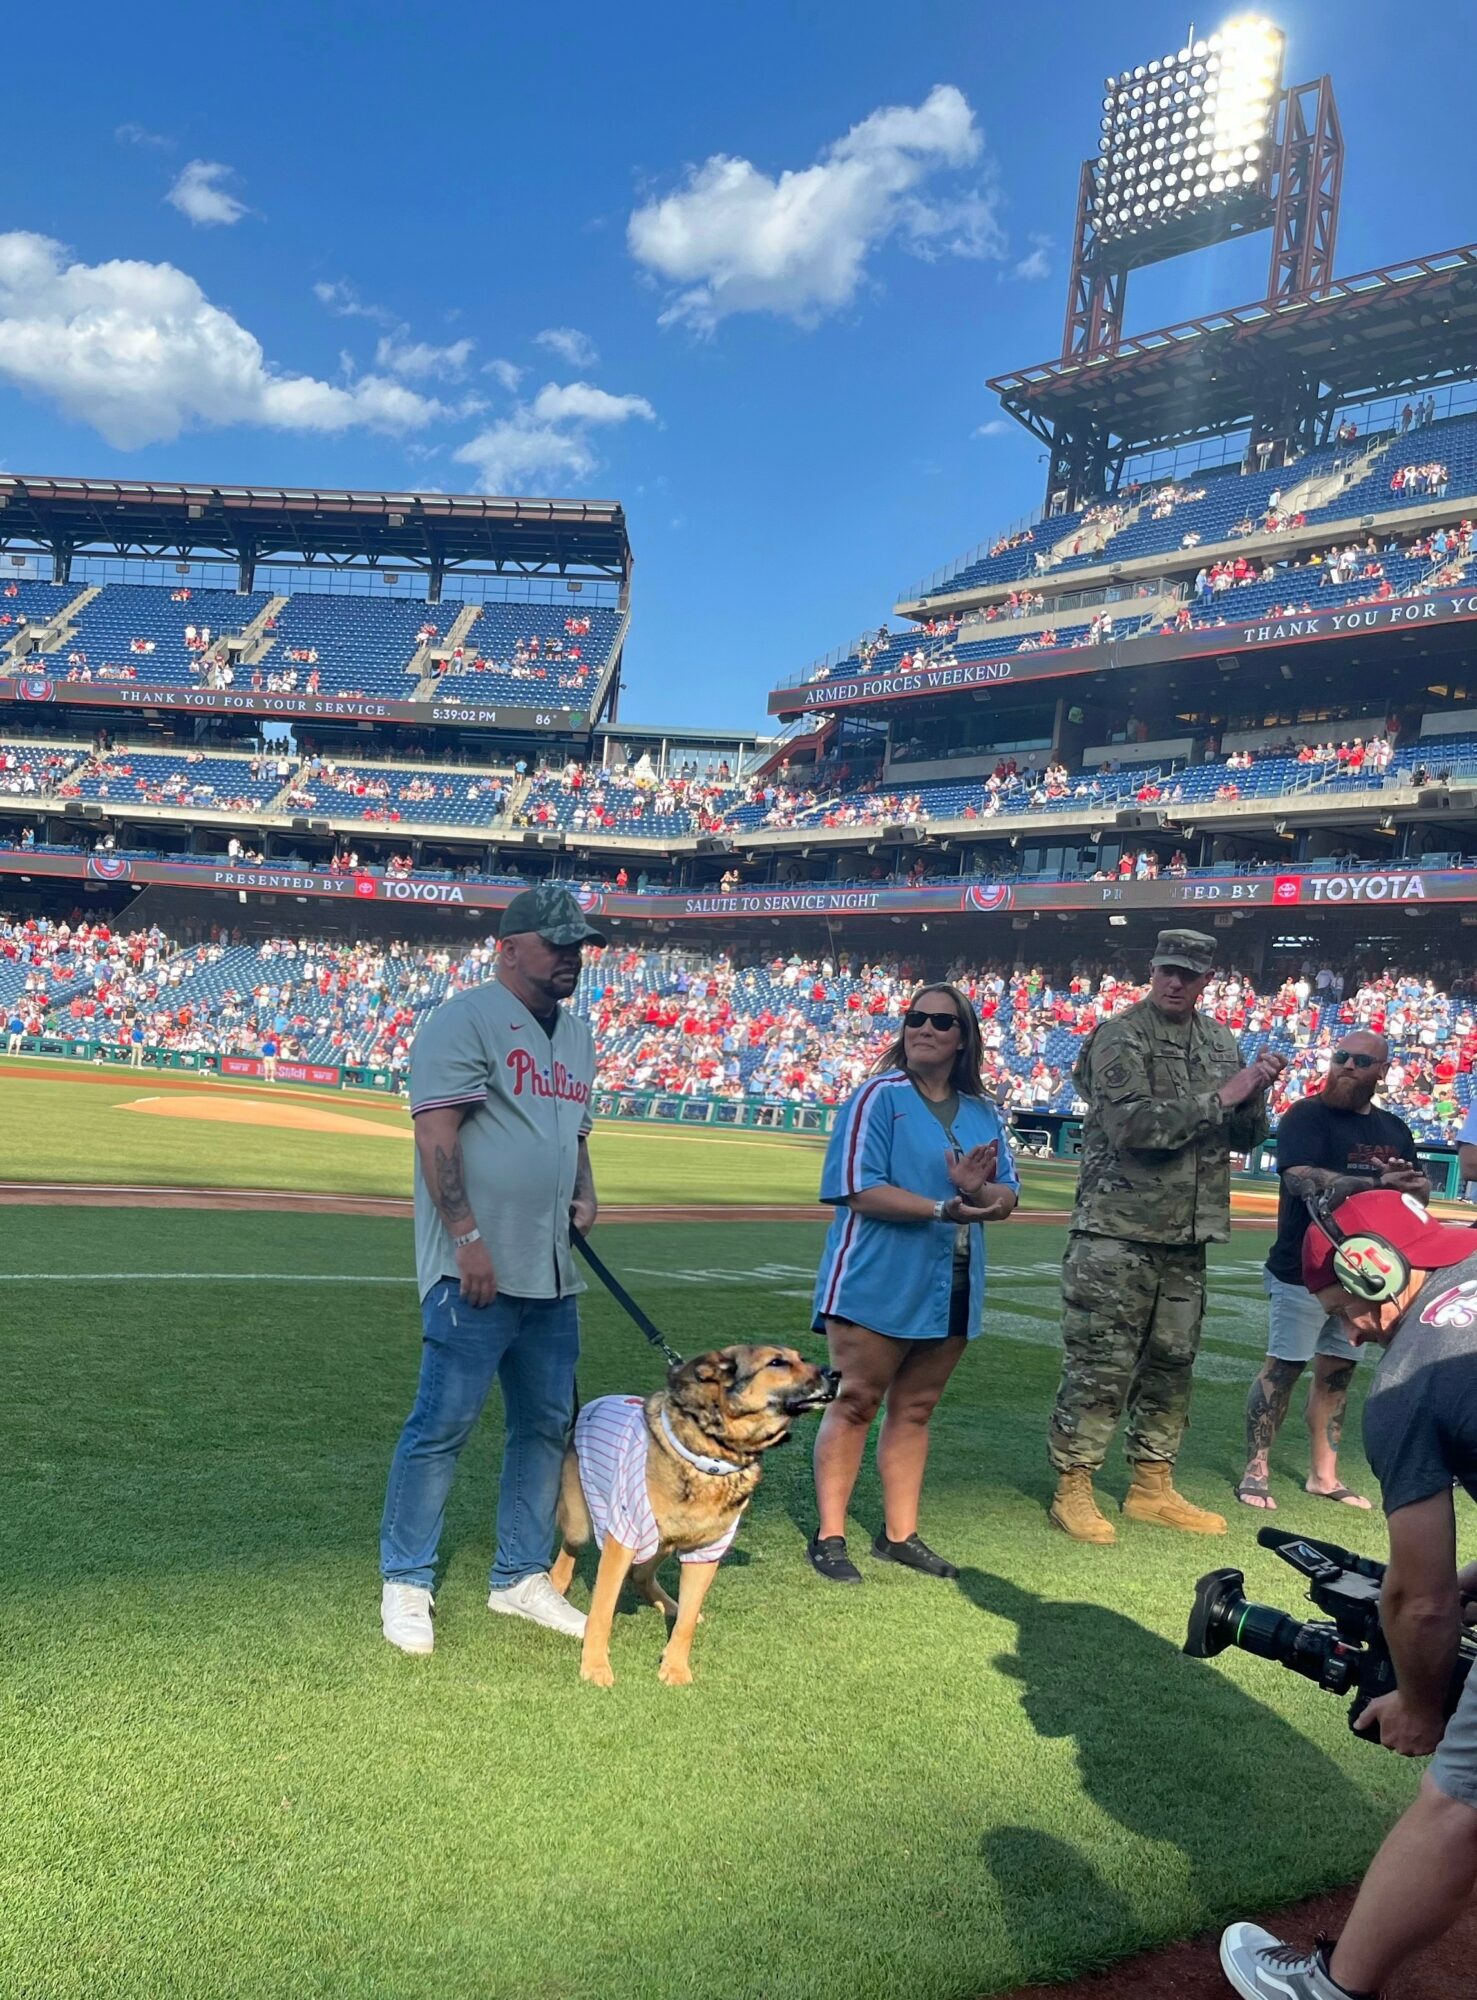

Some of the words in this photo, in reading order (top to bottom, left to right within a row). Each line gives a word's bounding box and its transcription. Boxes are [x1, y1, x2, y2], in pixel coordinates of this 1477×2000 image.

[1244, 619, 1319, 643] THANK
[1332, 611, 1378, 630] YOU
[1390, 603, 1437, 622] FOR
[805, 684, 858, 704] ARMED
[862, 675, 921, 697] FORCES
[927, 662, 1011, 687] WEEKEND
[120, 691, 175, 704] THANK
[184, 694, 216, 706] YOU
[223, 697, 255, 708] FOR
[263, 699, 306, 711] YOUR
[315, 702, 391, 716] SERVICE.
[432, 708, 476, 721] 5:39:02
[478, 711, 496, 722] PM
[215, 872, 315, 889] PRESENTED
[323, 881, 345, 891] BY
[383, 882, 464, 902] TOYOTA
[1231, 885, 1260, 899] BY
[1310, 875, 1425, 900] TOYOTA
[685, 898, 737, 912] SALUTE
[741, 897, 760, 911] TO
[763, 895, 825, 910] SERVICE
[829, 893, 879, 908] NIGHT
